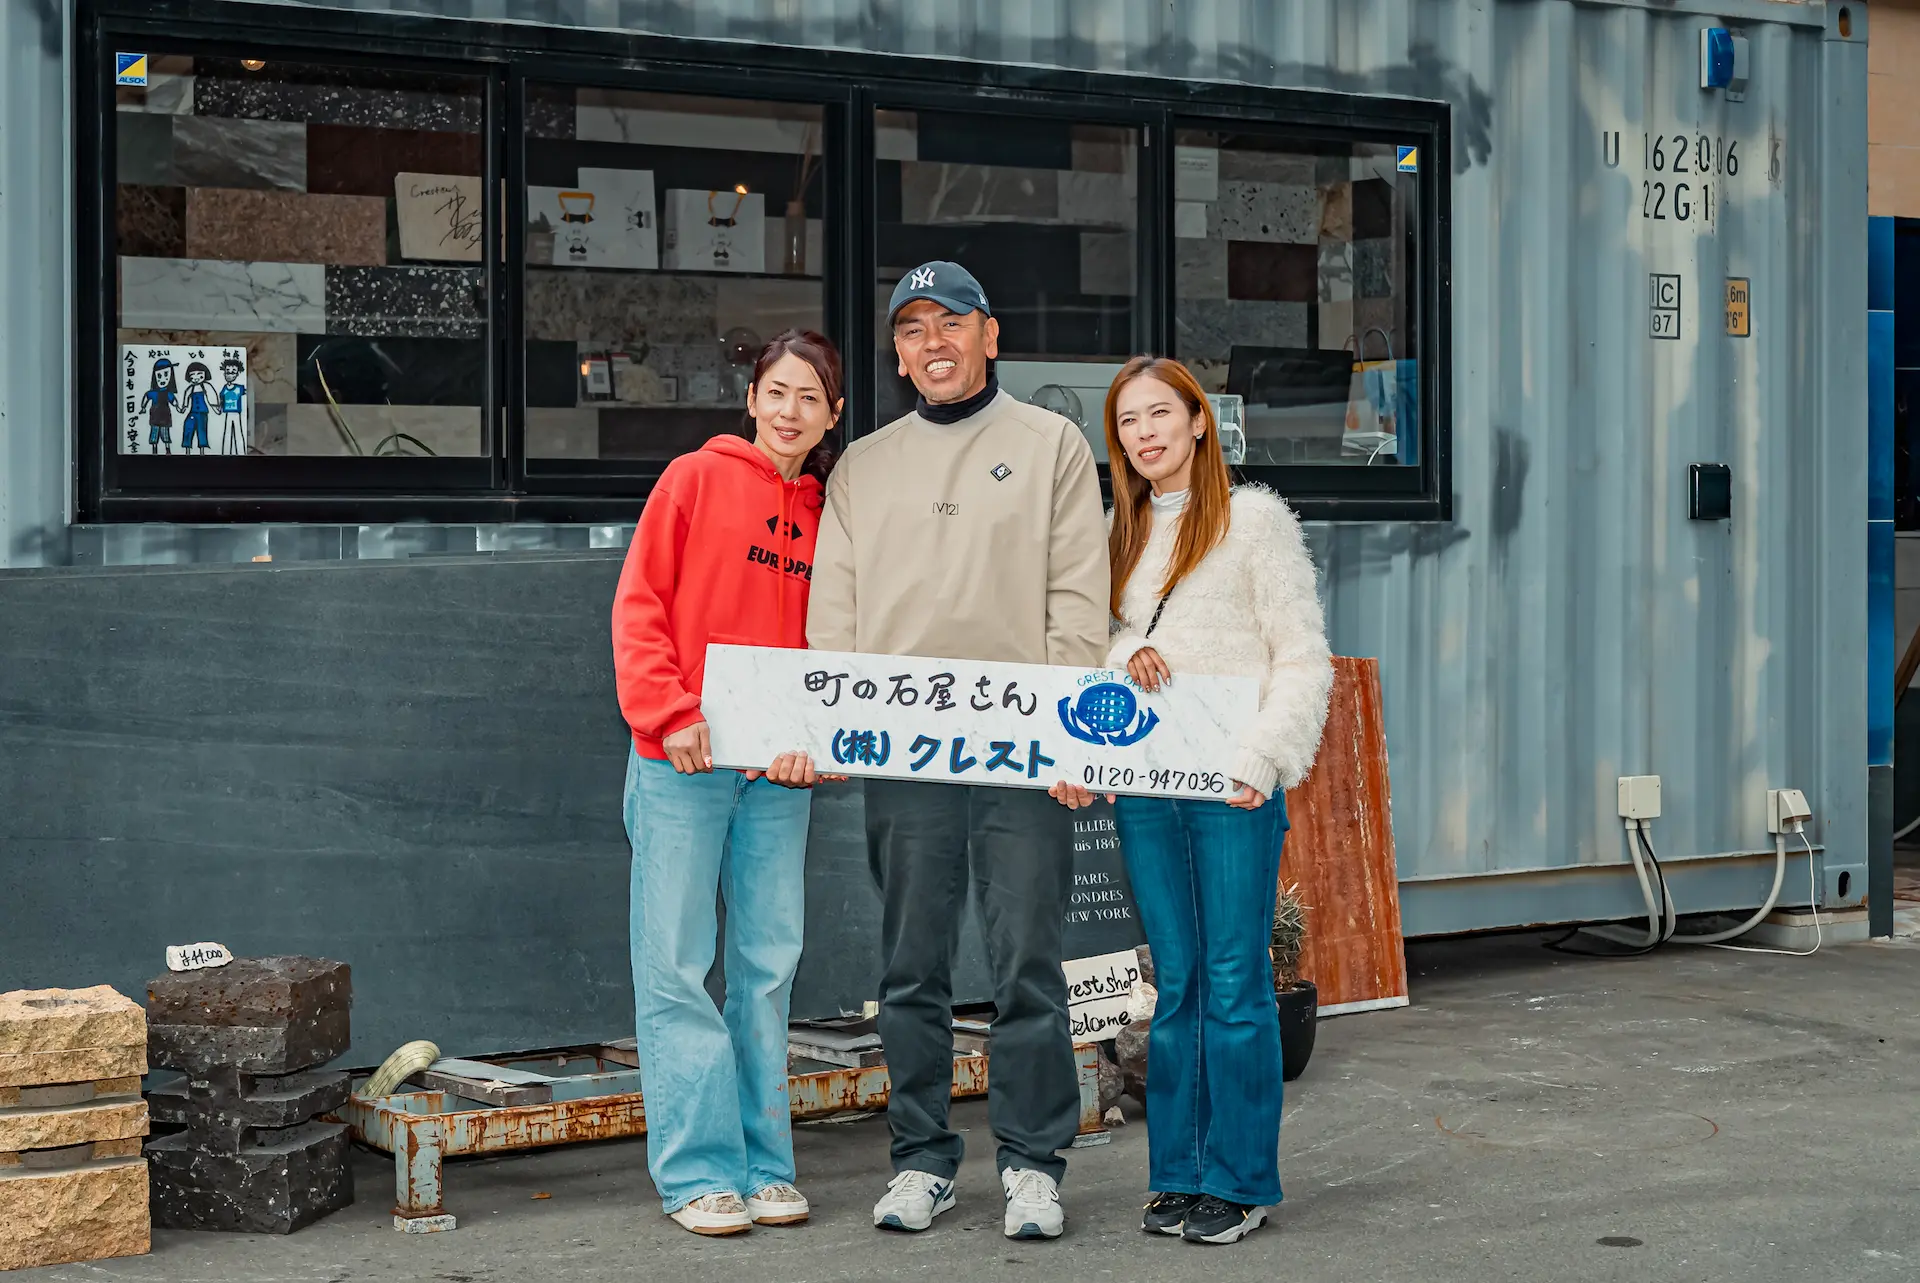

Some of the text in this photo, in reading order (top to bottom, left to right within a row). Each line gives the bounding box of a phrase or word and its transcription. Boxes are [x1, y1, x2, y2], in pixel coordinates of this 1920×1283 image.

[1603, 131, 1620, 169] U
[1652, 314, 1672, 333] 87
[804, 670, 1037, 716] 町の石屋さん
[1084, 765, 1225, 793] 0120-947036
[1074, 872, 1110, 886] PARIS
[1070, 889, 1124, 904] ONDRES
[1095, 906, 1132, 921] YORK
[1068, 975, 1104, 1000] rest
